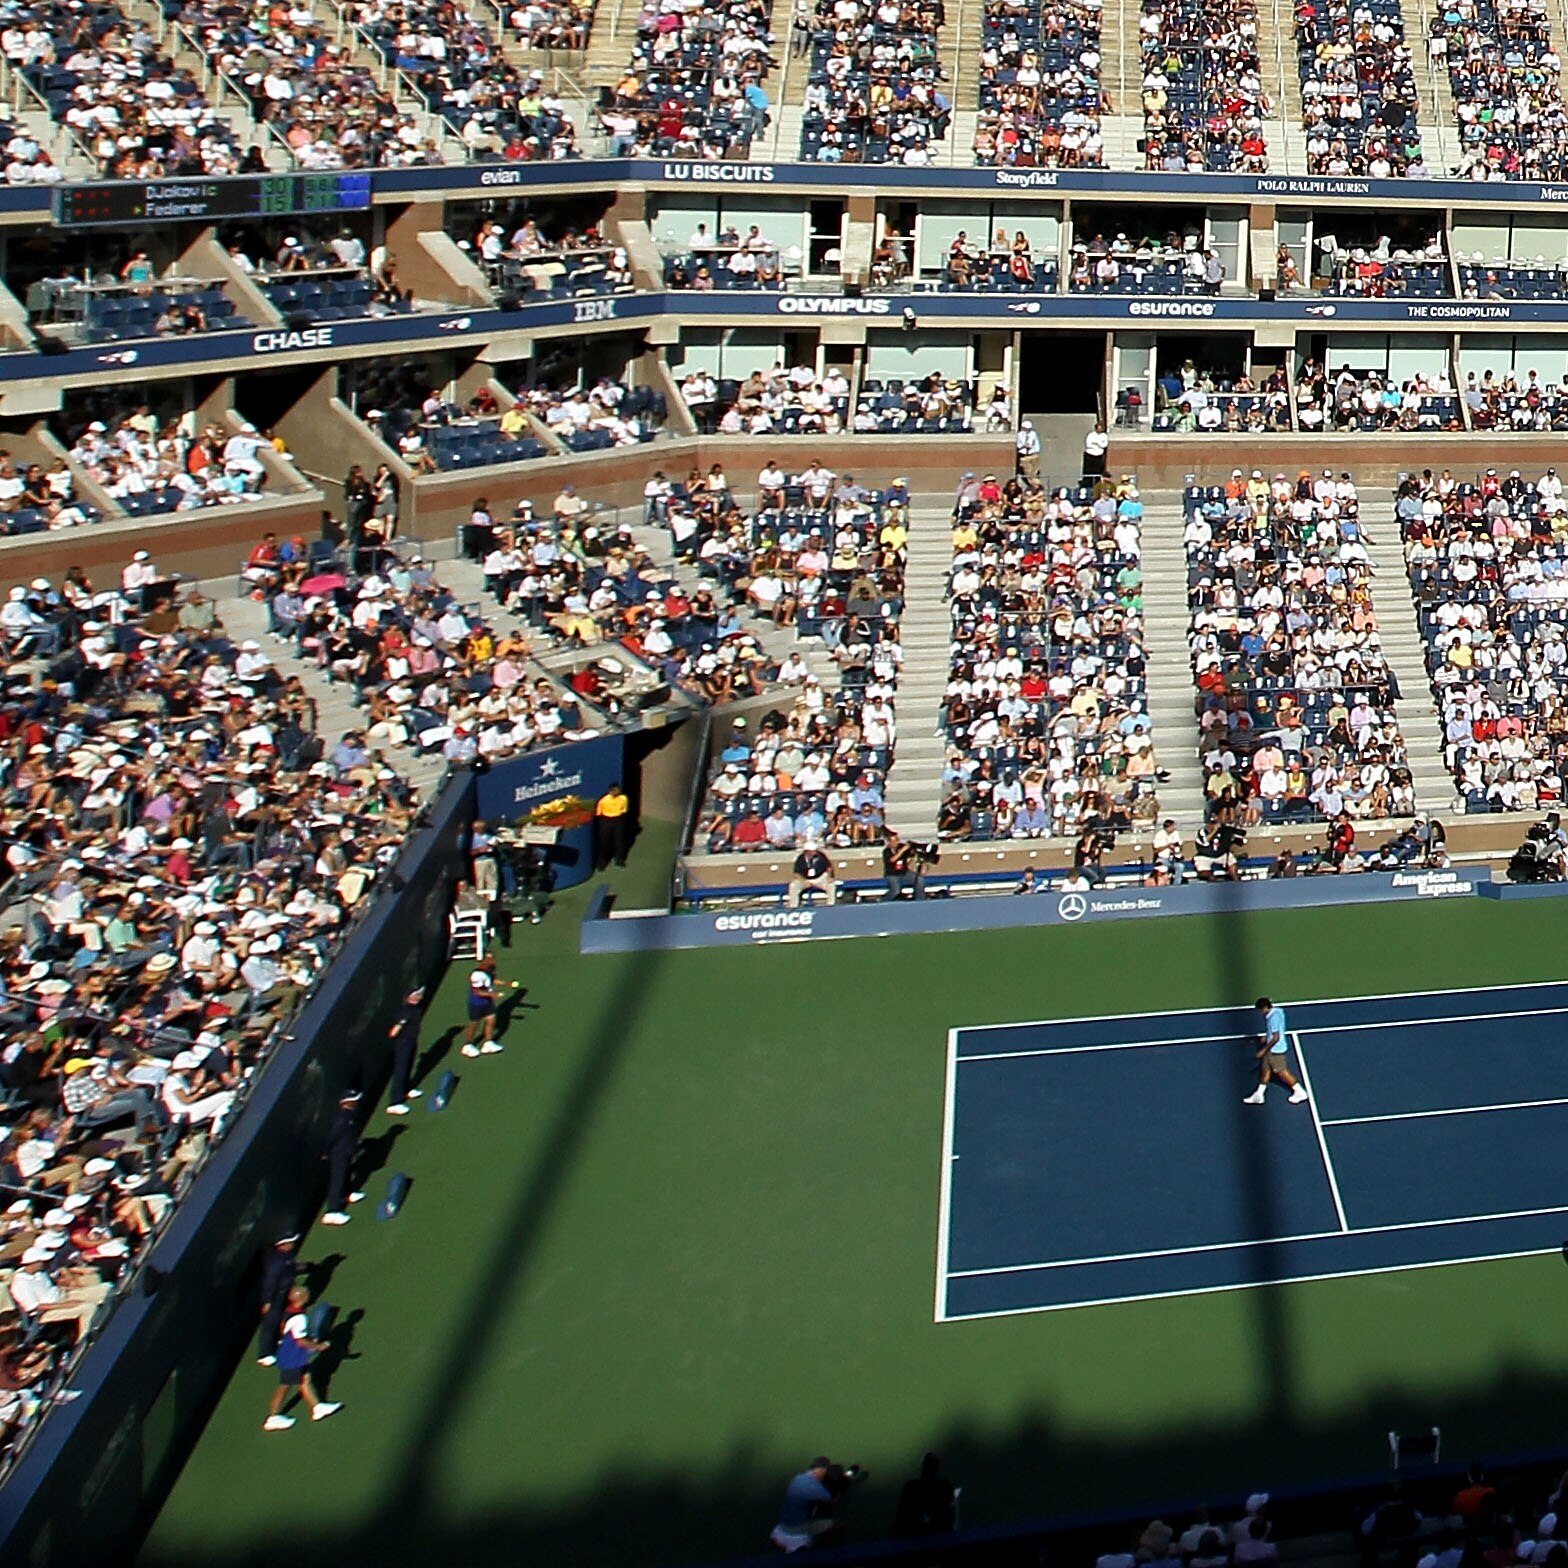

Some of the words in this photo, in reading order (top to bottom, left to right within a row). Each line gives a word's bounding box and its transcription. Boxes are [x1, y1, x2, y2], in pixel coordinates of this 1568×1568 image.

[481, 168, 521, 185] evian
[664, 164, 690, 179] LU
[692, 165, 775, 182] BISCUITS
[996, 171, 1059, 188] Stonyfield
[1257, 180, 1287, 192] POLO
[1289, 180, 1324, 193] RALPH
[1327, 182, 1370, 194] LAUREN
[145, 202, 207, 216] Federer
[574, 299, 617, 322] IBM
[778, 298, 892, 313] OLYMPUS
[1129, 302, 1215, 316] esurance
[1408, 306, 1428, 317] THE
[1430, 306, 1510, 318] COSMOPOLITAN
[254, 328, 333, 352] CHASE
[514, 773, 583, 803] Heineken
[1392, 871, 1457, 887] American
[1418, 881, 1472, 897] Express
[1091, 899, 1162, 913] Mercedes-Benz
[716, 911, 814, 931] esurance
